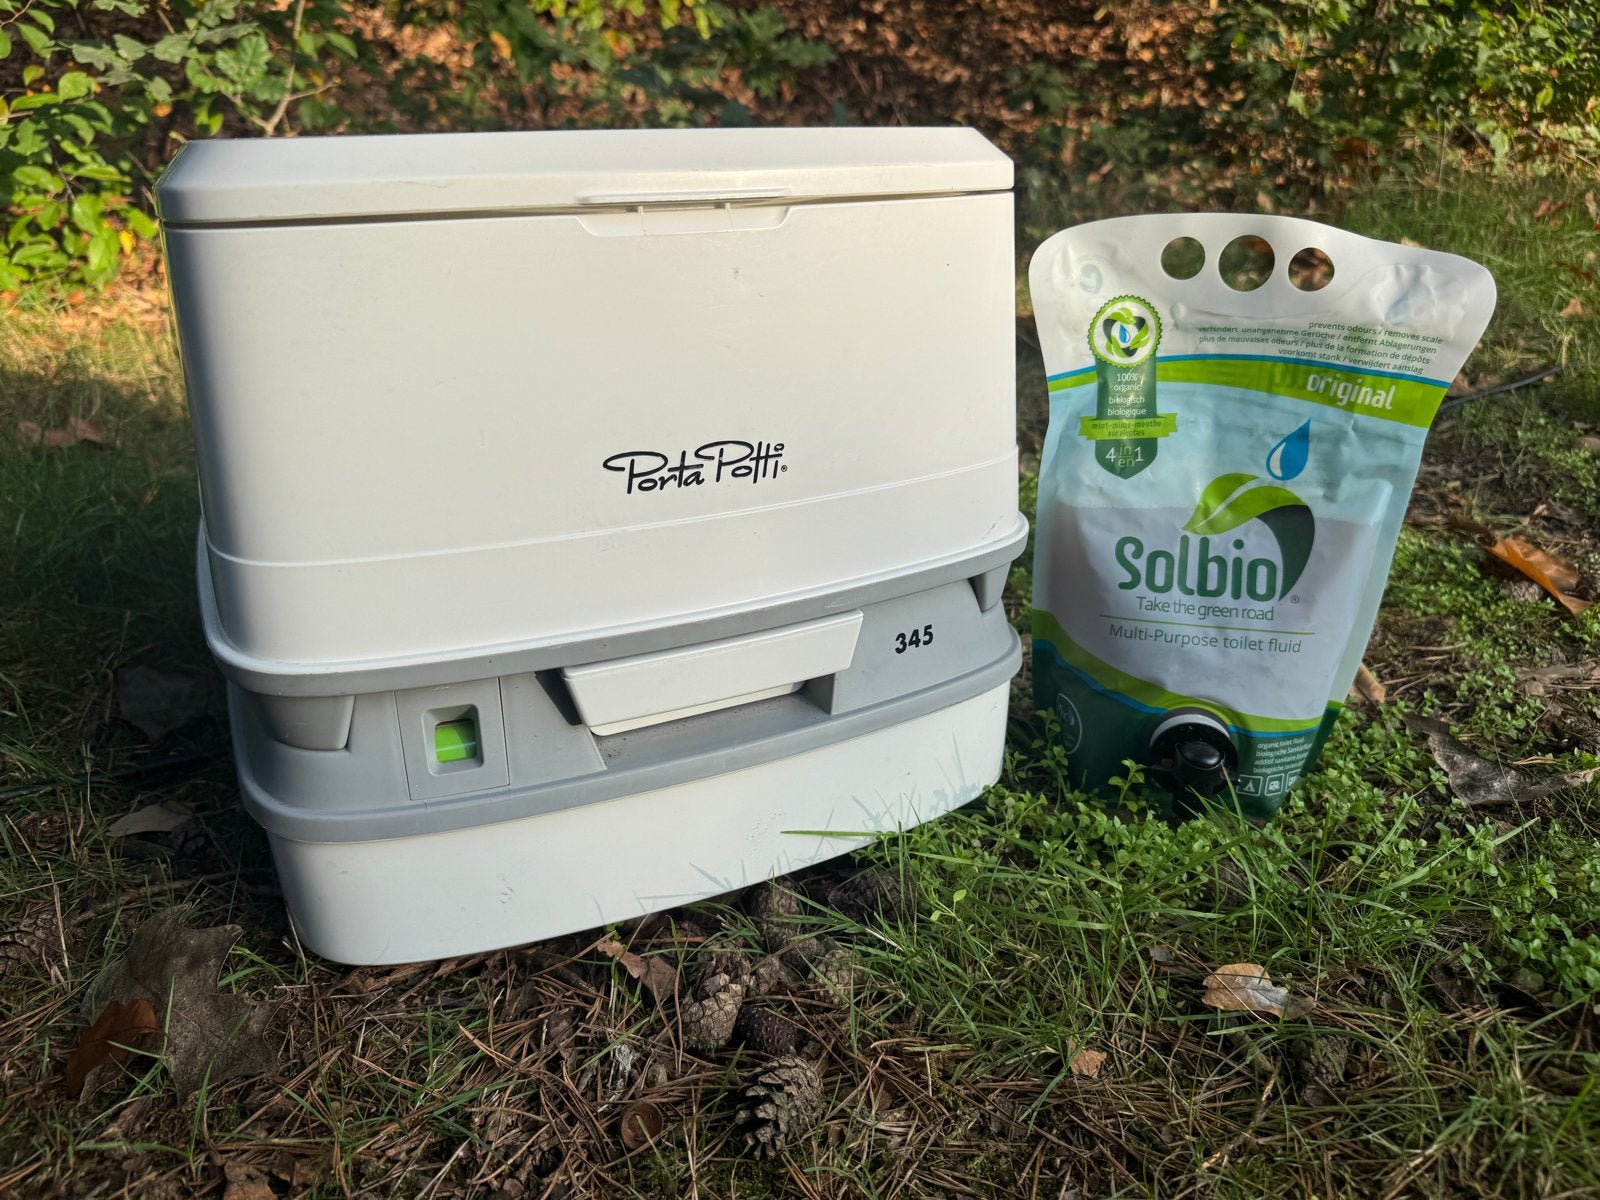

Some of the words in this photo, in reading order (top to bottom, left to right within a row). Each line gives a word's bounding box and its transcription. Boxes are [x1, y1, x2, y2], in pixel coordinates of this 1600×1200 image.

[1242, 327, 1299, 336] unangenehme
[1301, 330, 1335, 340] Gerüche
[1343, 334, 1377, 345] entfernt
[1378, 338, 1437, 354] Ablagerungen
[1308, 321, 1345, 331] prevents
[1347, 325, 1377, 335] odours
[1384, 330, 1420, 341] removes
[1422, 334, 1443, 344] scale
[1199, 336, 1215, 344] plus
[1228, 336, 1269, 344] mauvaises
[1271, 337, 1299, 346] odeurs
[1305, 340, 1323, 350] plus
[1325, 342, 1335, 351] de
[1337, 343, 1344, 352] la
[1346, 344, 1388, 358] formation
[1390, 351, 1400, 360] de
[1401, 352, 1430, 364] dépôts
[1278, 348, 1317, 358] voorkomt
[1318, 352, 1341, 361] stank
[1348, 356, 1391, 369] verwijdert
[1392, 363, 1424, 375] aanslag
[1113, 383, 1141, 393] organic
[1116, 373, 1138, 382] 100%
[1108, 396, 1145, 406] biologisch
[1306, 373, 1396, 410] original
[1107, 408, 1147, 417] biologique
[1106, 447, 1117, 463] 4
[1120, 445, 1132, 455] in
[1134, 446, 1143, 462] 1
[1118, 458, 1134, 467] en
[602, 451, 704, 494] Porta
[1115, 534, 1277, 602] Solbio
[1136, 596, 1170, 613] Take
[1172, 599, 1195, 615] the
[1198, 604, 1238, 620] green
[1241, 606, 1274, 621] road
[895, 624, 934, 655] 345
[1109, 623, 1218, 648] Multi-Purpose
[1223, 635, 1263, 652] toilet
[1268, 638, 1301, 653] fluid
